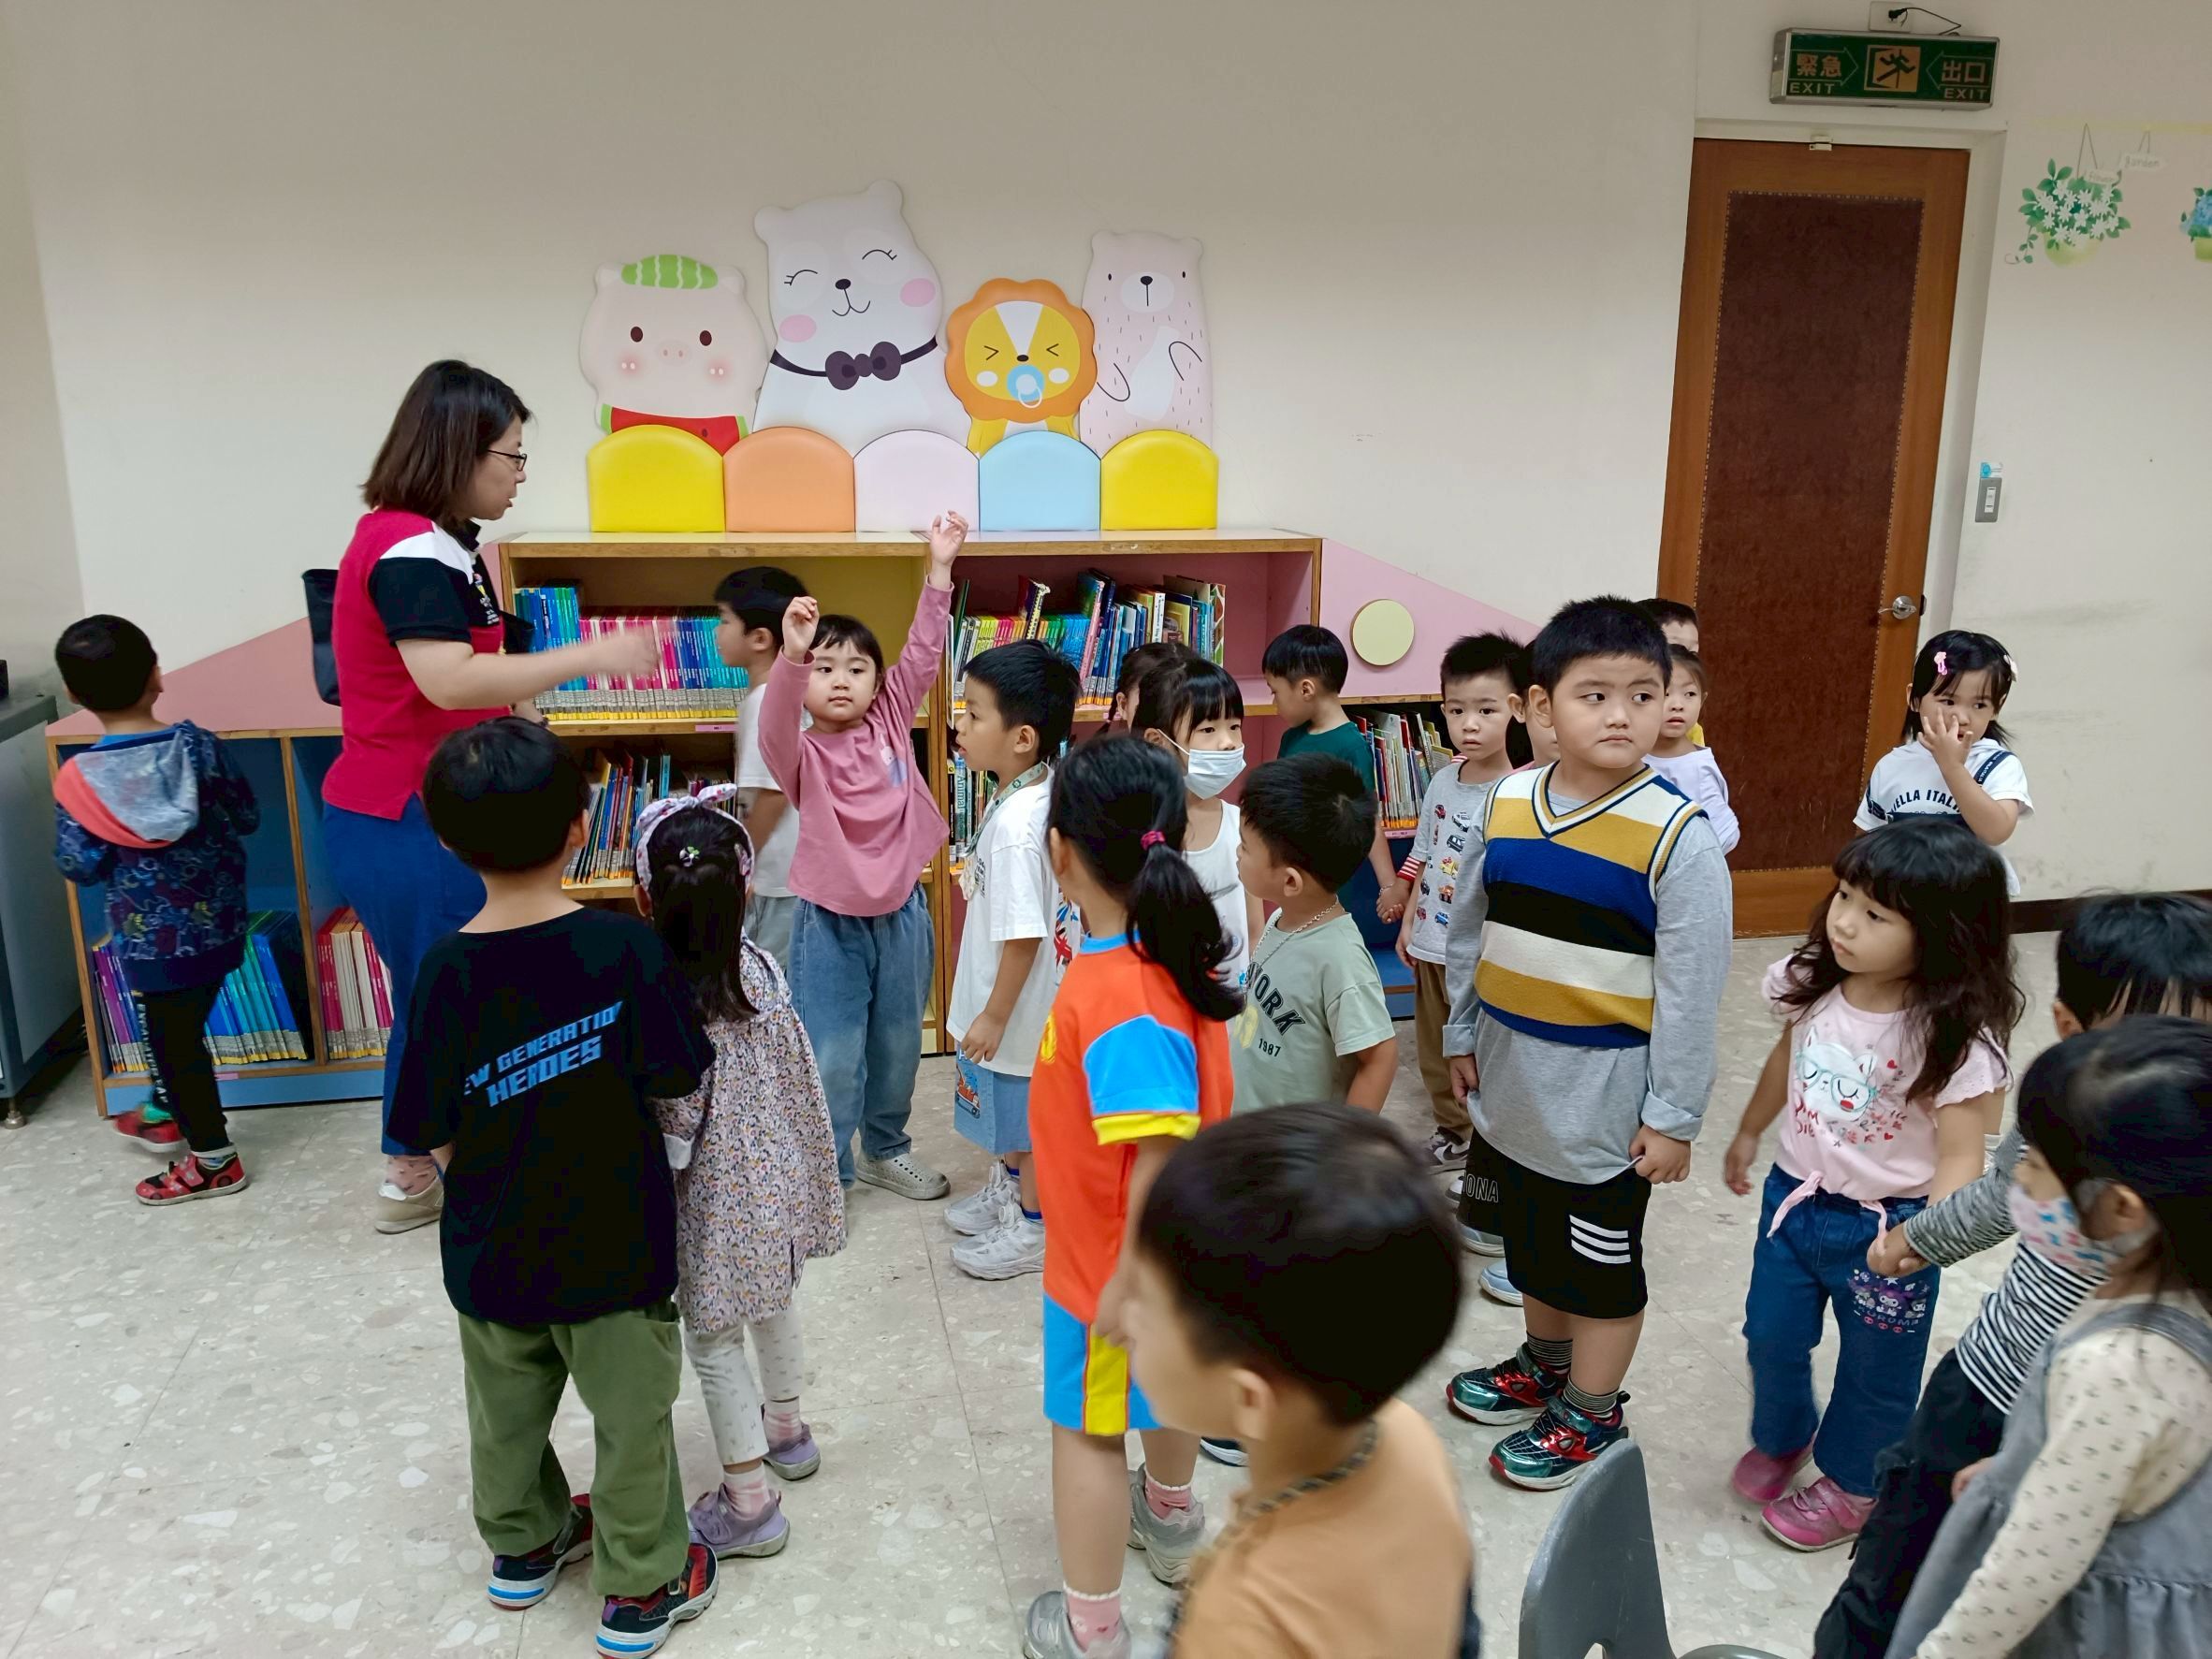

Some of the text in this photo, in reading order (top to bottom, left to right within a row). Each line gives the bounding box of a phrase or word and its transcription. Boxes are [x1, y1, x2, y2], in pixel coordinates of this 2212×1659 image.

[1797, 53, 1841, 77] 緊急
[1941, 60, 1986, 83] 出口
[1789, 82, 1835, 95] EXIT
[1944, 88, 1987, 100] EXIT
[1258, 1038, 1282, 1057] 1987
[486, 1035, 603, 1108] HEROES
